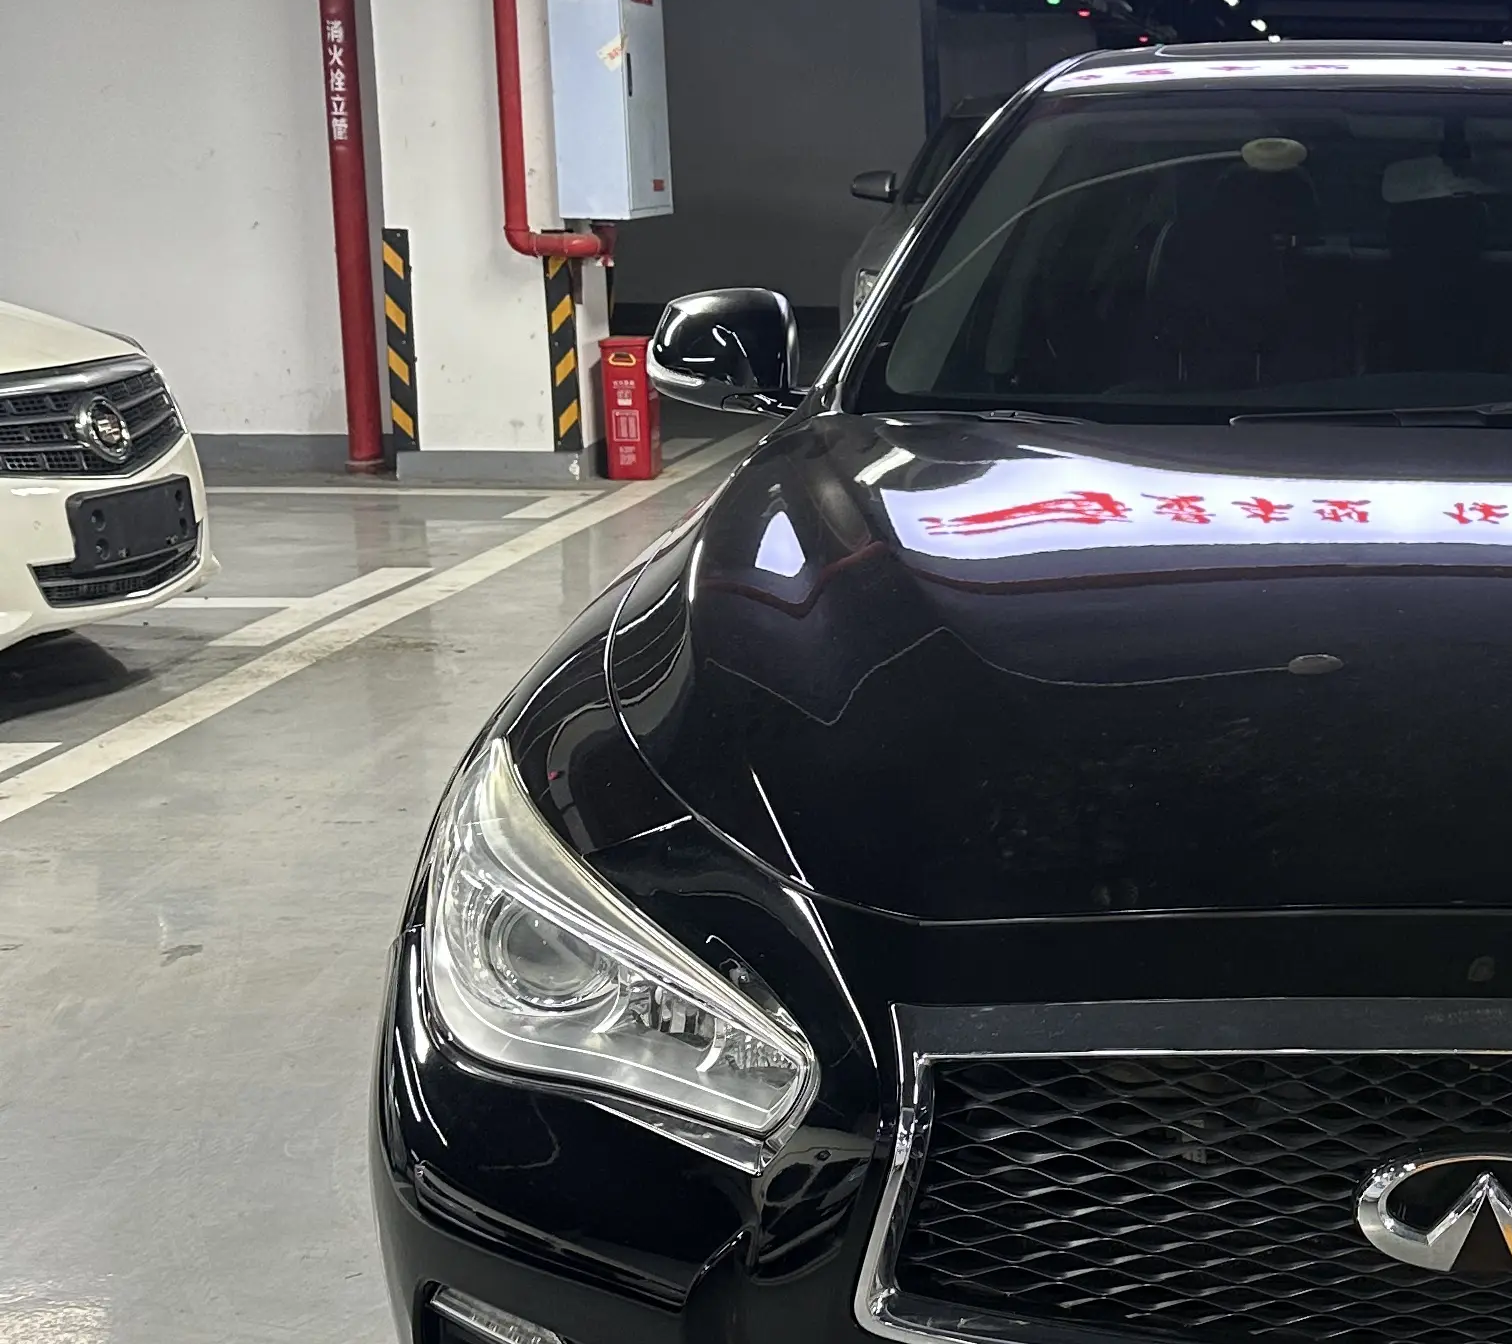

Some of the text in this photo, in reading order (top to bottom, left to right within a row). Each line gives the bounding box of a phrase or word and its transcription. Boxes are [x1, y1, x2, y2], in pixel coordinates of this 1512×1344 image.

[326, 19, 349, 141] 消火栓立管
